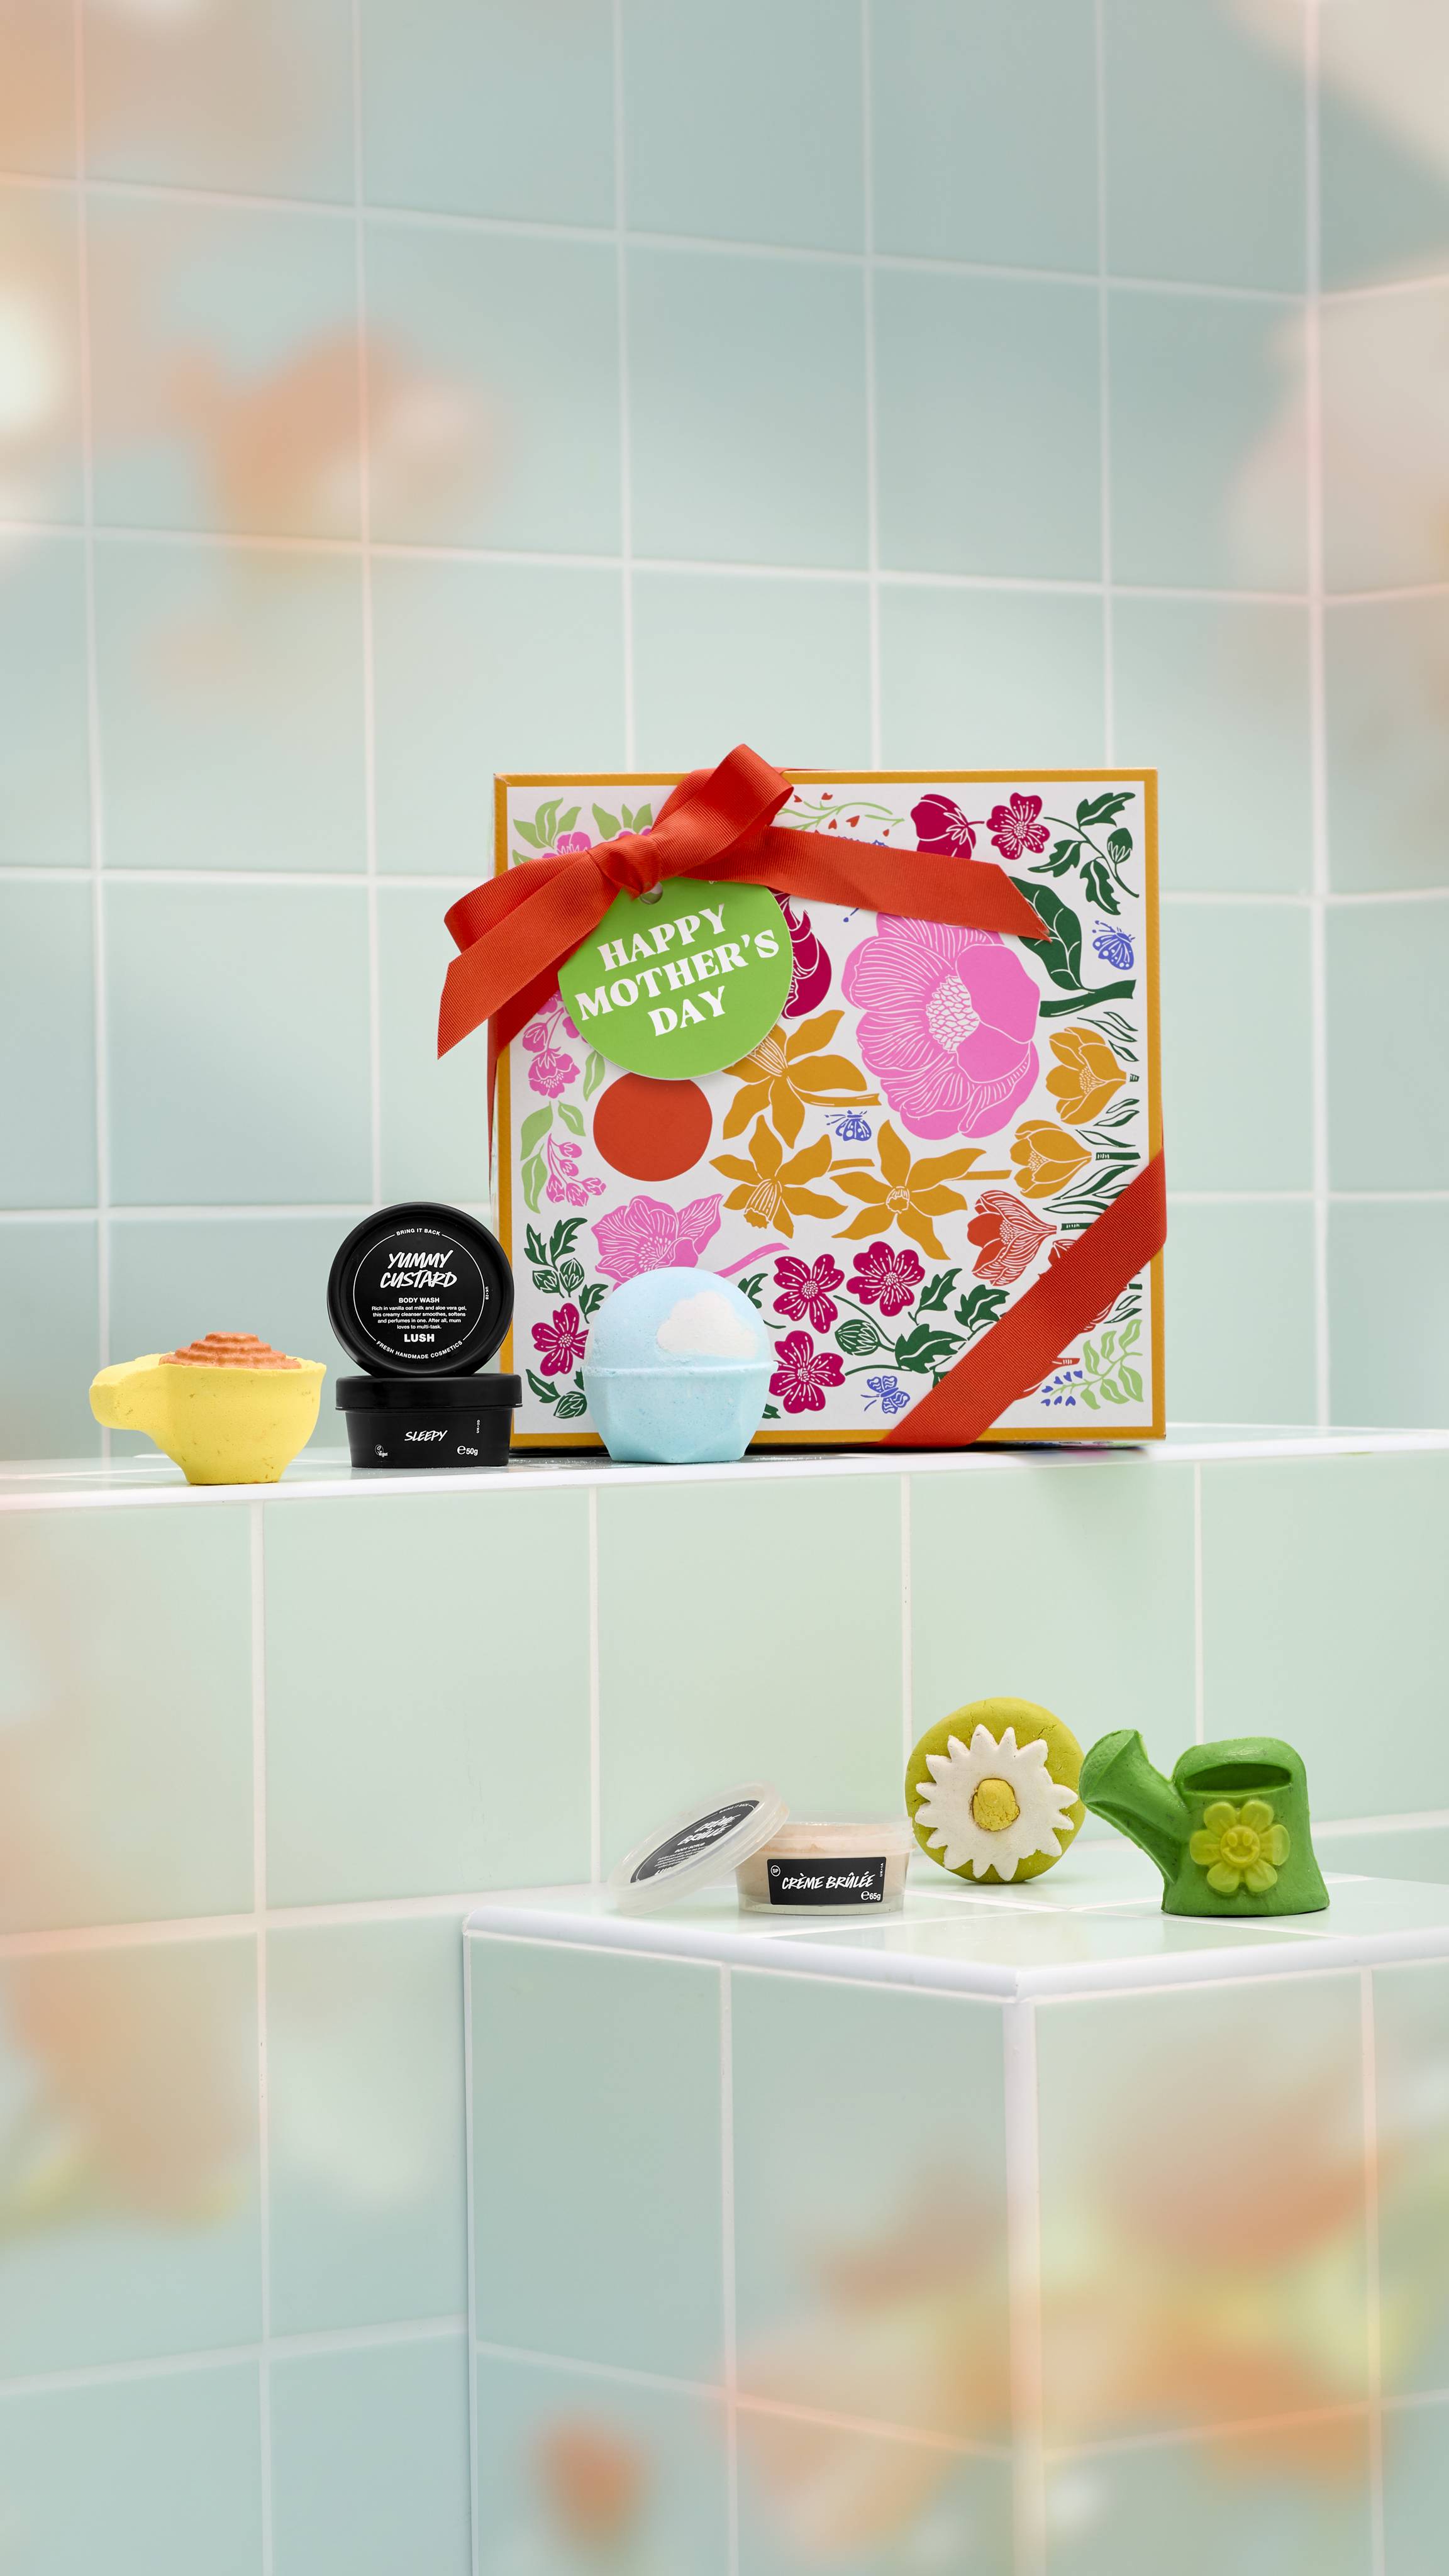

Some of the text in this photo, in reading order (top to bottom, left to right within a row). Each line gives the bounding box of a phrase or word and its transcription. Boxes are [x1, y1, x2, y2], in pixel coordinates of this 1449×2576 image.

[597, 903, 726, 972] HAPPY
[574, 930, 779, 1021] MOTHER'S
[647, 985, 726, 1036] DAY
[387, 1250, 453, 1269] YUMMY
[380, 1270, 457, 1289] CUSTARD
[404, 1333, 435, 1342] LUSH
[376, 1340, 463, 1359] FRESH HANDMADE COSMETICS
[404, 1430, 448, 1441] SLEEPY
[782, 1871, 875, 1890] CRÈME BRÛLÉE
